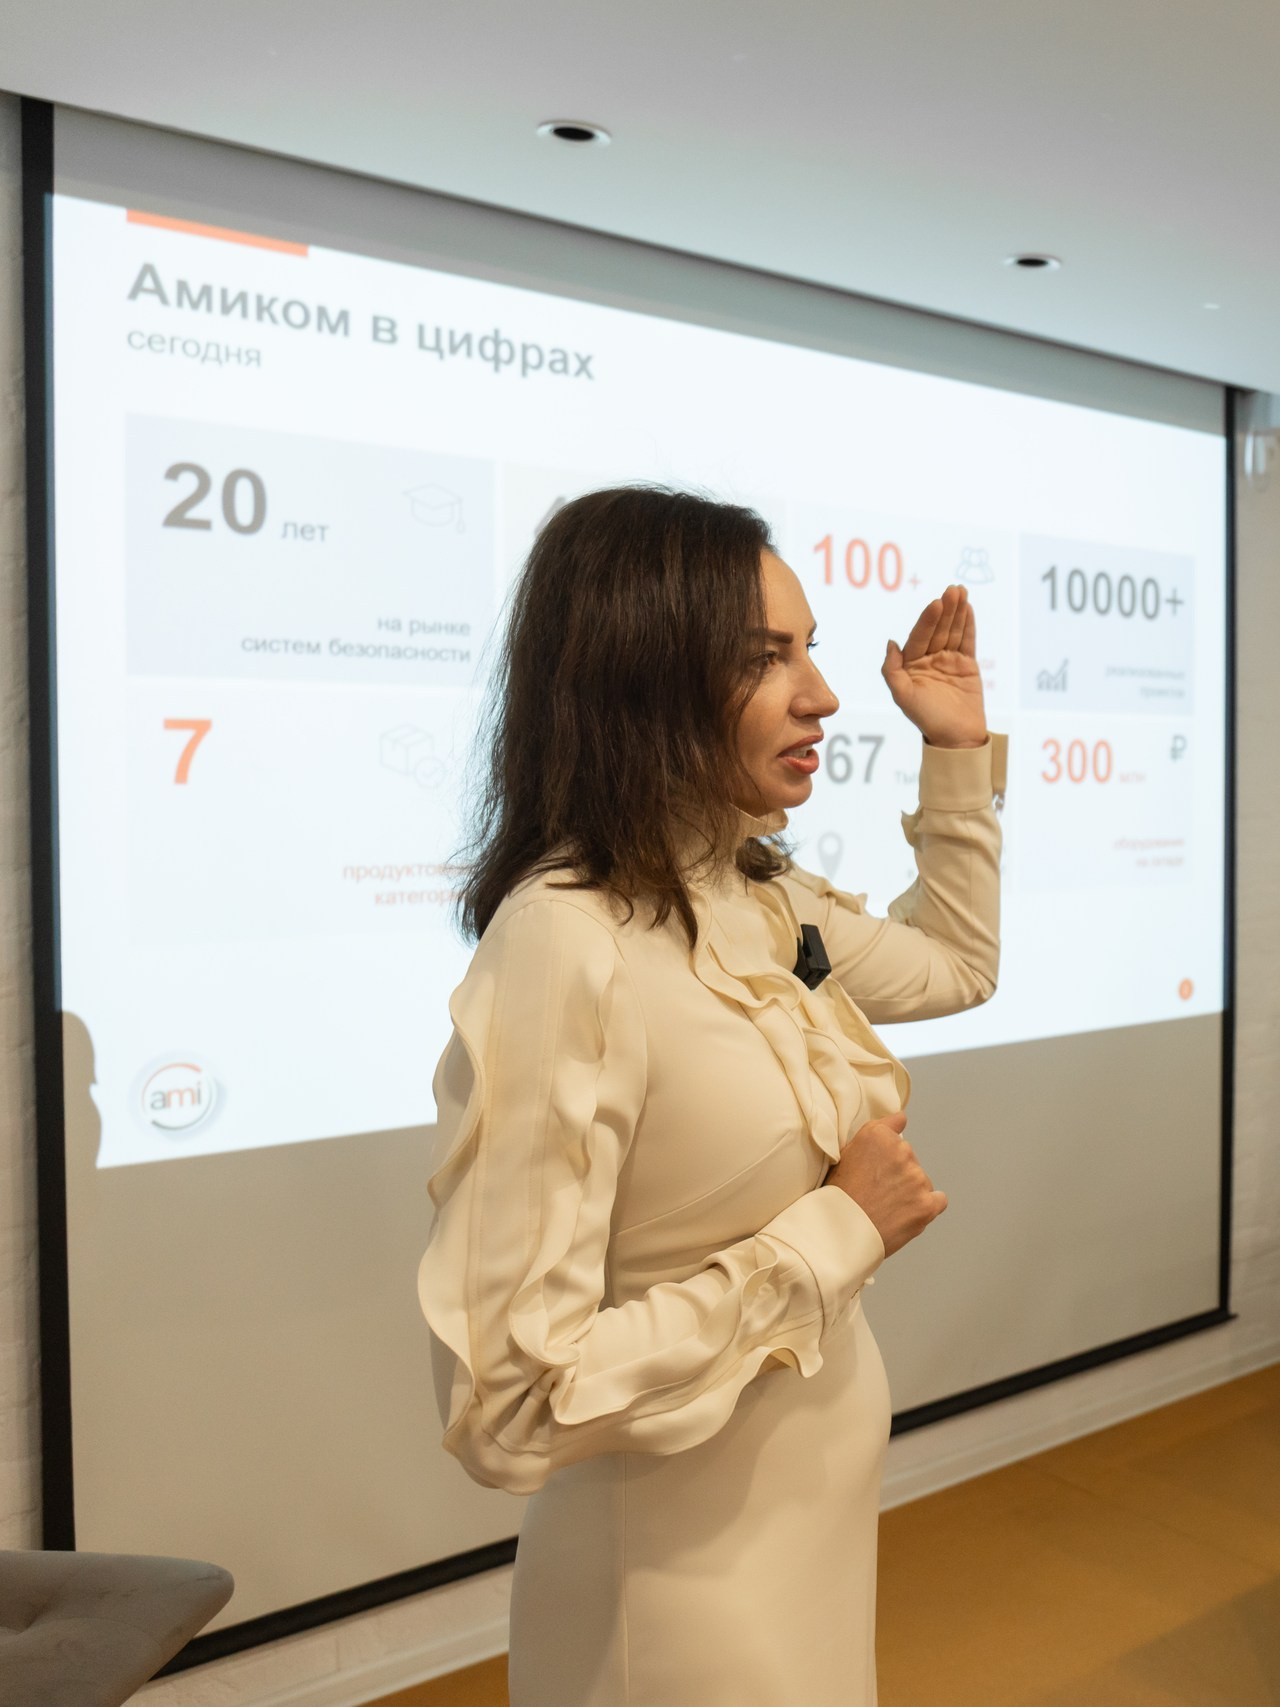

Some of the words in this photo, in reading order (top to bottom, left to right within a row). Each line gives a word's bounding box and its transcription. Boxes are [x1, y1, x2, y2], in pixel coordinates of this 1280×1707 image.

[126, 261, 351, 338] Амиком
[370, 313, 399, 346] в
[417, 321, 595, 381] цифрах
[126, 328, 263, 369] сегодня
[160, 459, 269, 537] 20
[280, 517, 330, 543] лет
[1040, 563, 1186, 622] 10000+
[240, 636, 322, 656] систем
[328, 637, 472, 663] безопасности
[377, 616, 402, 632] на
[408, 618, 472, 637] рынке
[161, 716, 214, 786] 7
[1040, 737, 1114, 785] 300
[149, 1081, 203, 1111] ami
